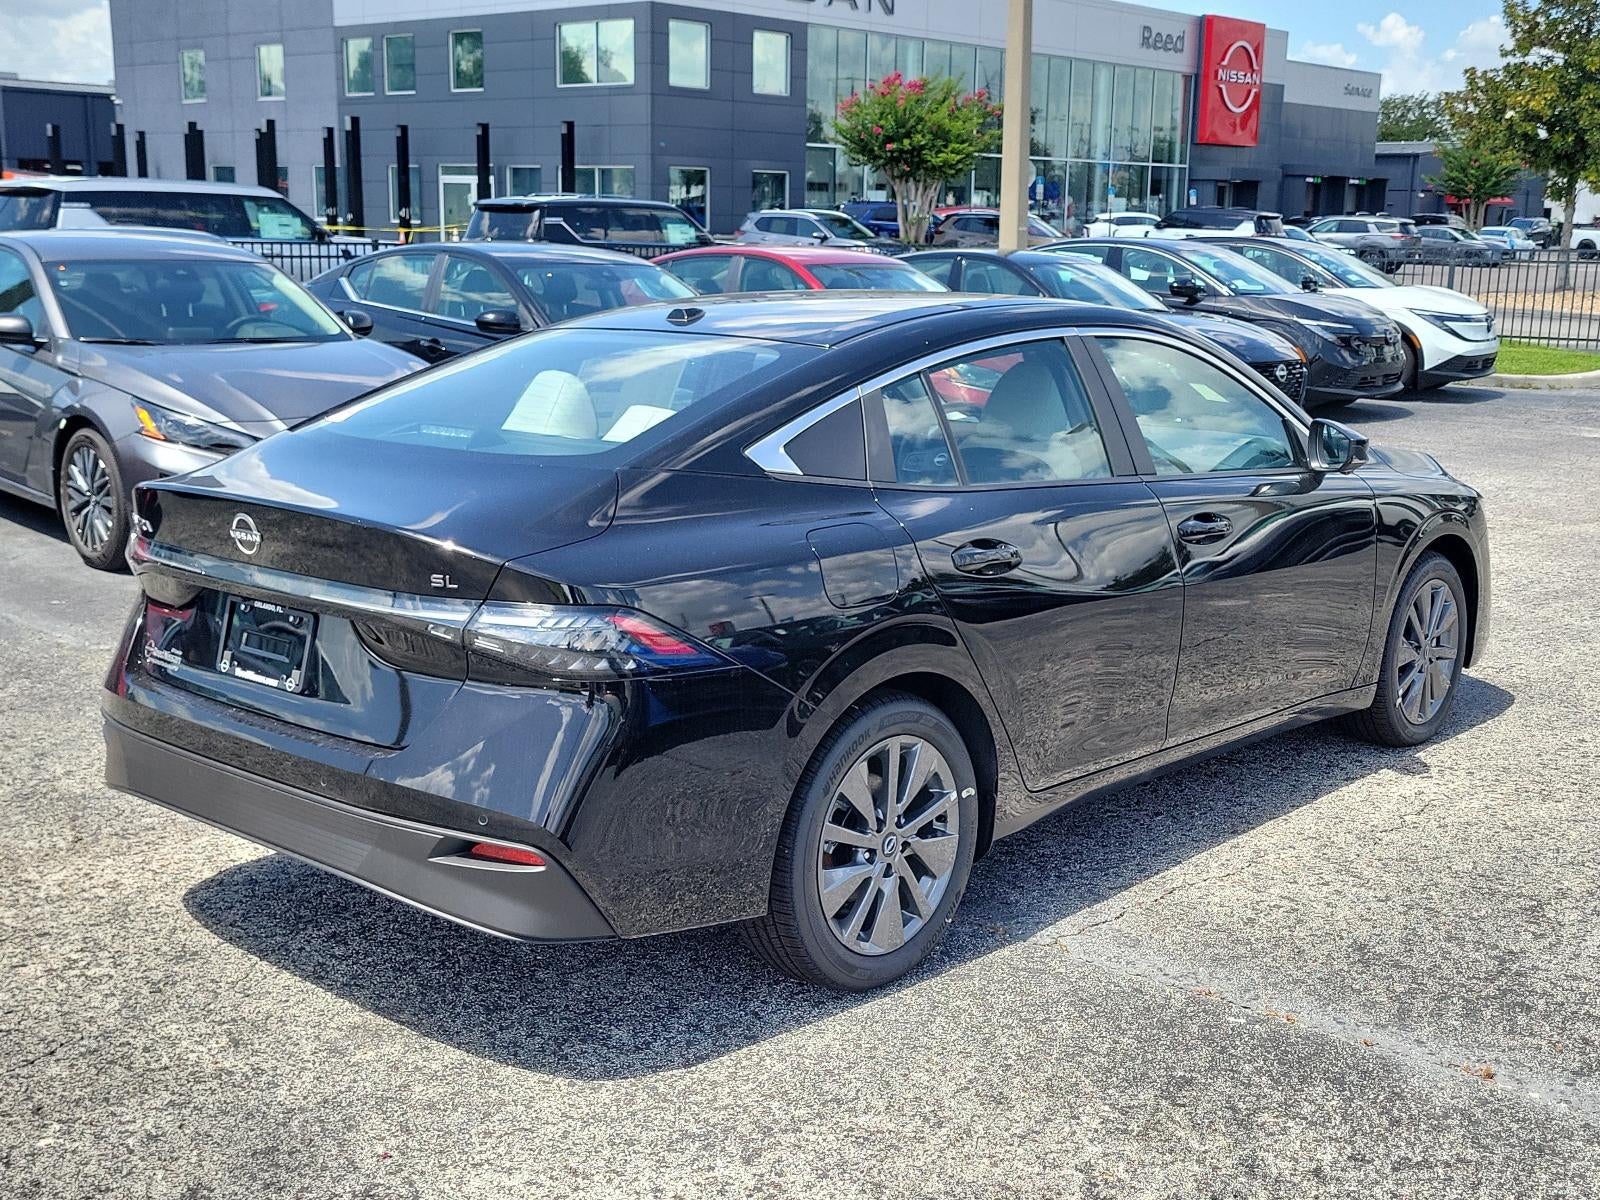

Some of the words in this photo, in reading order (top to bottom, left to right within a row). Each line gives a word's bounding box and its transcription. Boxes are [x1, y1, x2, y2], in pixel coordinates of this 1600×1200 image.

[1141, 25, 1185, 53] Reed
[1217, 69, 1262, 85] NISSAN
[229, 529, 261, 543] NISSAN
[430, 574, 459, 588] SL
